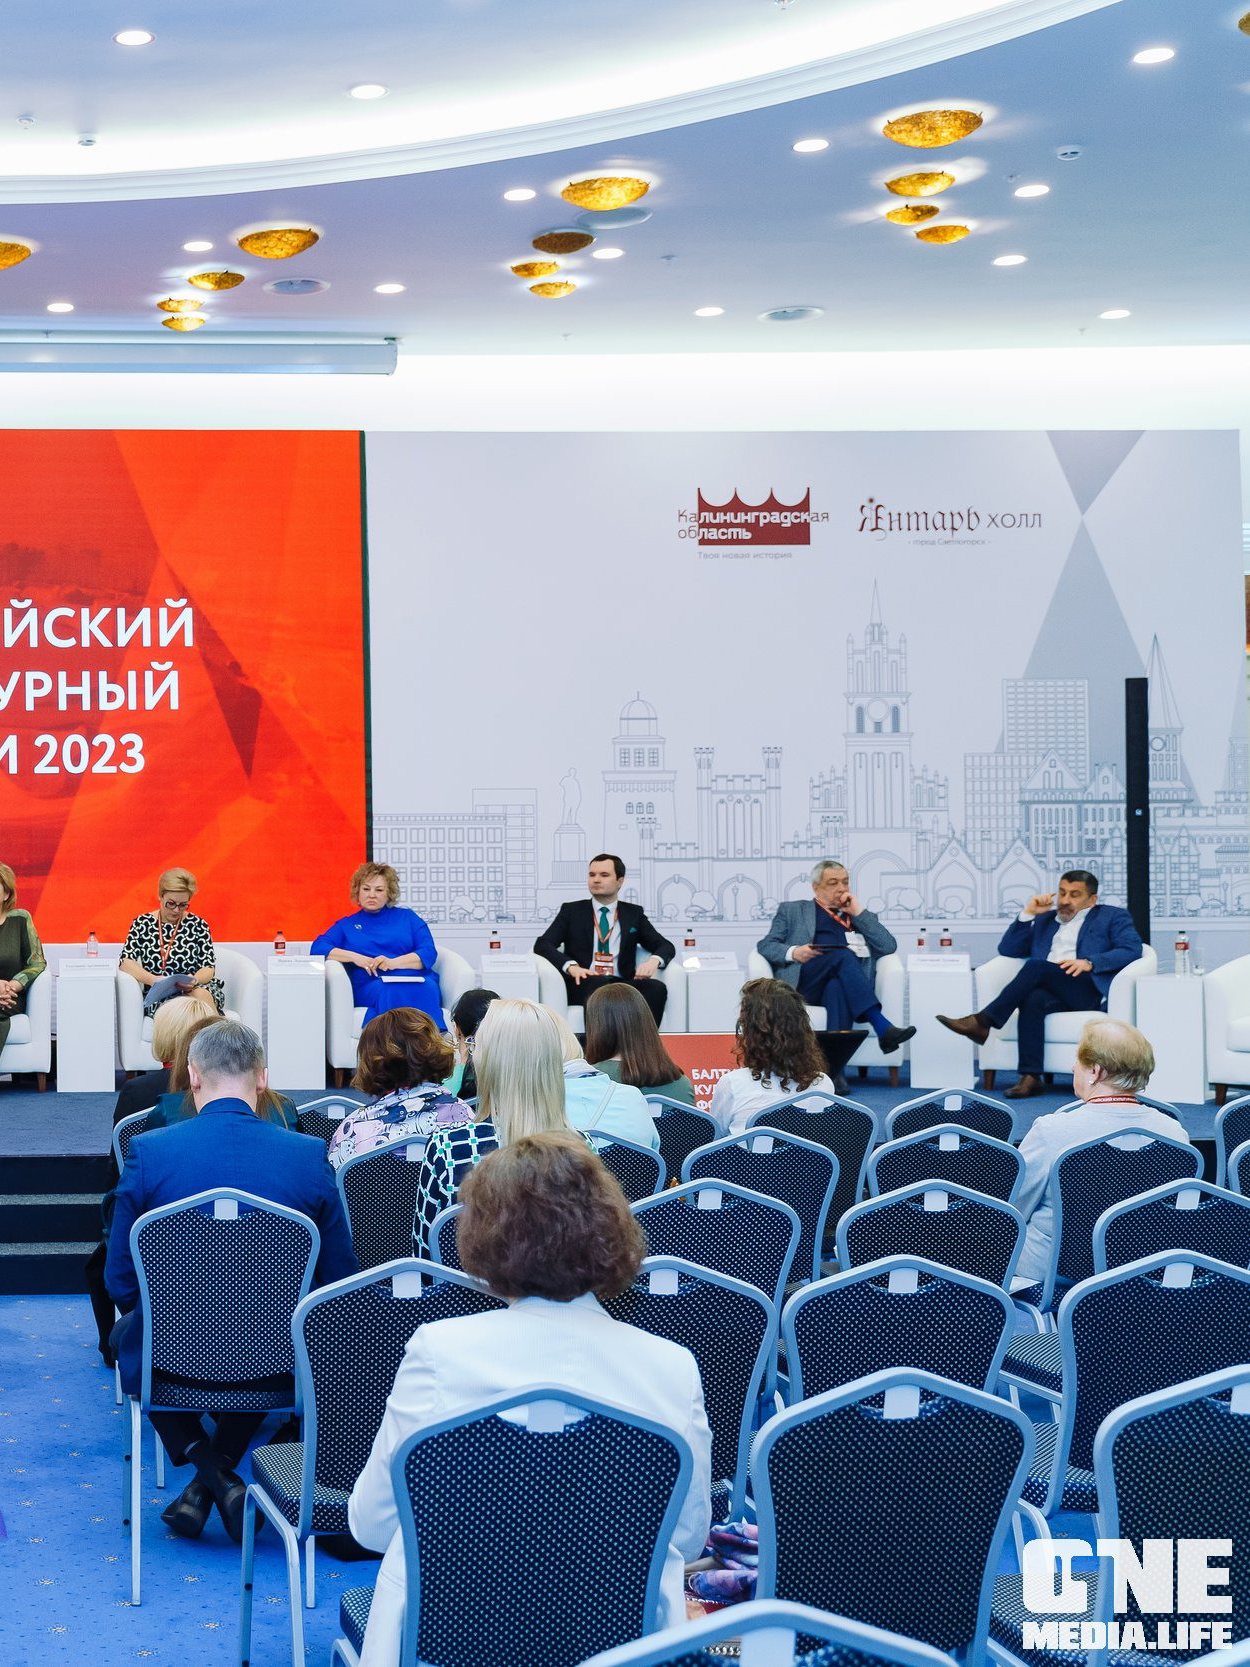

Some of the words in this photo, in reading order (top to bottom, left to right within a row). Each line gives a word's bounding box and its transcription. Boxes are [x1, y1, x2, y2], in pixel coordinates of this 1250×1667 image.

[678, 509, 830, 527] Калининградская
[986, 513, 1042, 528] холл
[678, 525, 752, 540] область
[33, 733, 145, 775] 2023
